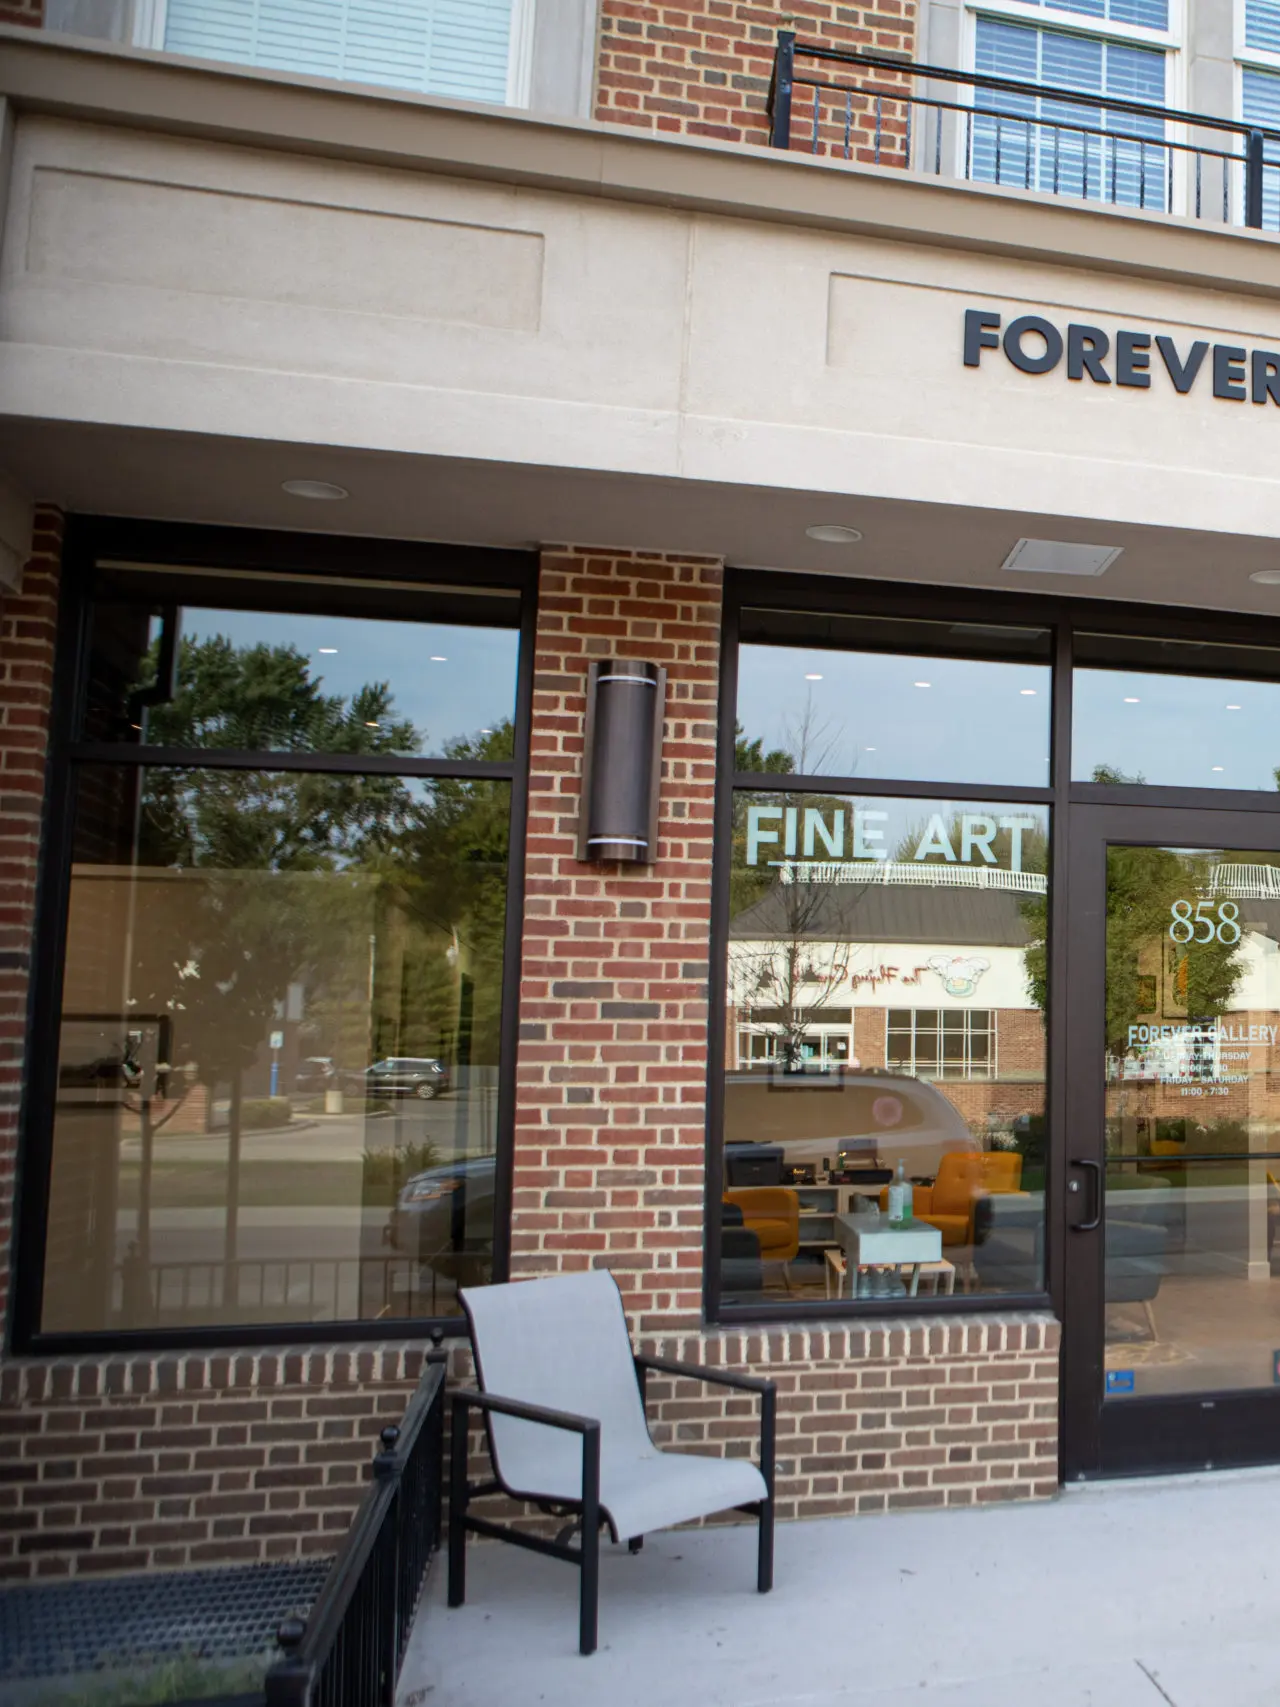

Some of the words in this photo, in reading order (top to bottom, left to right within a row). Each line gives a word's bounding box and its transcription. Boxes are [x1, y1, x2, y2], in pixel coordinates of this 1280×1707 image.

[746, 806, 889, 866] FINE
[914, 812, 1035, 873] ART
[1169, 899, 1242, 945] 858
[1128, 1024, 1203, 1047] FOREVER
[1209, 1024, 1279, 1046] GALLERY
[1160, 1076, 1193, 1085] FRIDAY
[1201, 1075, 1249, 1085] SATURDAY
[1180, 1087, 1203, 1097] 11:00
